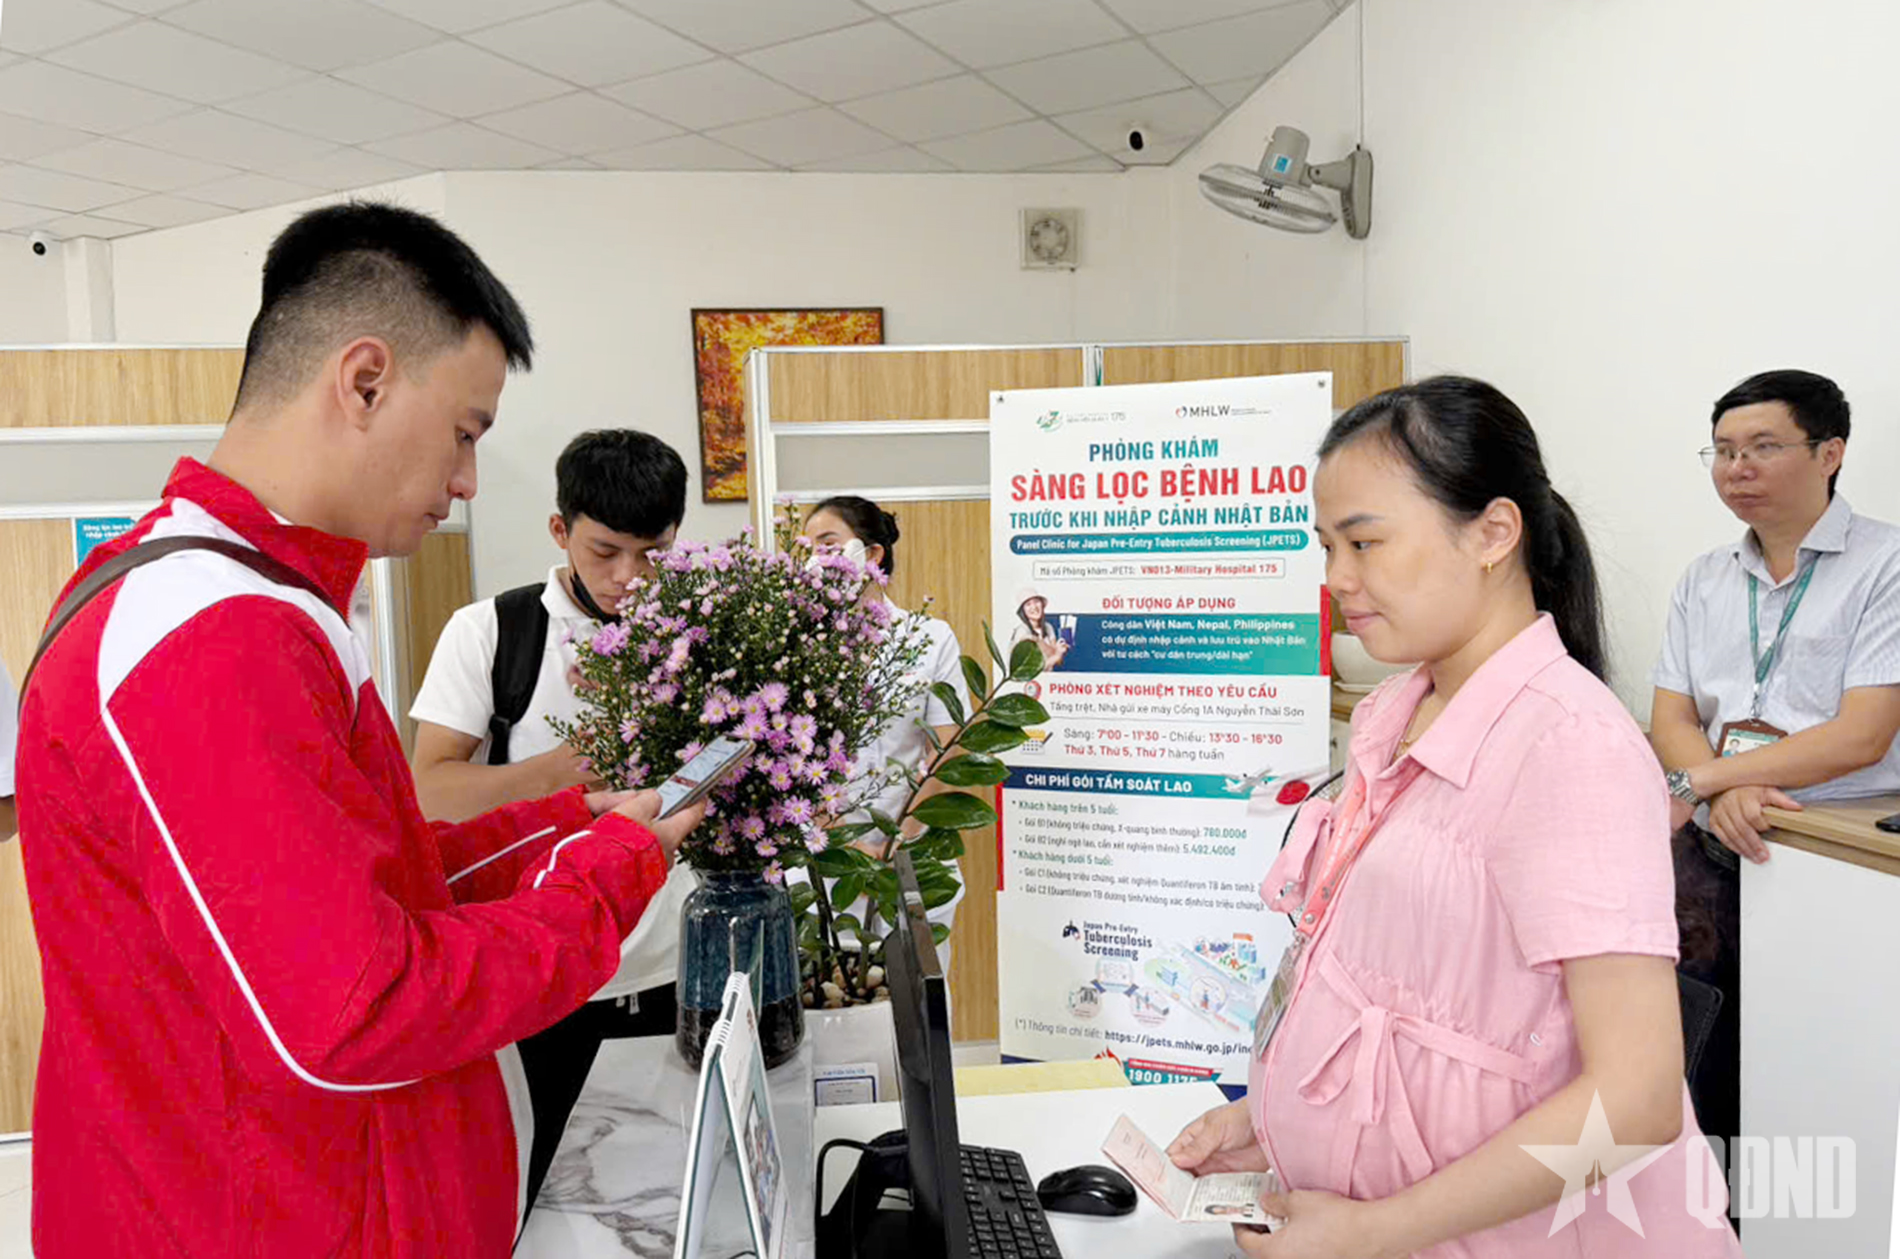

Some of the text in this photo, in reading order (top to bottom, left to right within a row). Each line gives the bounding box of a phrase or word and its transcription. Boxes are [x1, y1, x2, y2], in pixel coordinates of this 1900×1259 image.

[1189, 405, 1230, 417] MHLW
[1089, 435, 1218, 462] PHÒNG KHÁM
[1011, 463, 1307, 505] SÀNG LỌC BỆNH LAO
[1009, 500, 1308, 530] TRƯỚC KHI NHẬP CẢNH NHẬT BẢN
[1017, 534, 1301, 550] Panel Clinic for Japan Pre-Entry Tuberculosis Screening (JPETS)
[1062, 565, 1086, 577] Phòng
[1109, 566, 1136, 575] JPETS:
[1215, 564, 1256, 576] Hospital
[1260, 564, 1277, 574] 175
[1102, 594, 1236, 612] ĐỐI TƯỢNG ÁP DỤNG
[1101, 619, 1295, 632] Công dân Việt Nam, Nepal, Philippines
[1127, 635, 1147, 646] định
[1148, 635, 1171, 647] nhập
[1261, 635, 1285, 647] Nhật
[1127, 650, 1150, 660] cách
[1049, 681, 1277, 699] PHÒNG XÉT NGHIỆM THEO YÊU CẦU
[1203, 705, 1216, 715] 1A
[1216, 704, 1256, 718] Nguyễn
[1283, 706, 1305, 717] Sơn
[1087, 745, 1097, 757] 3,
[1122, 746, 1133, 758] 5,
[1159, 748, 1166, 758] 7
[1168, 748, 1197, 761] hàng
[1025, 774, 1047, 785] CHI
[1049, 771, 1070, 787] PHÍ
[1072, 774, 1094, 789] GÓI
[1126, 777, 1161, 791] SOÁT
[1164, 780, 1193, 792] LAO
[1019, 801, 1045, 811] Khách
[1047, 802, 1068, 814] hàng
[1091, 804, 1096, 813] 5
[1203, 827, 1247, 838] 780.000đ
[1018, 850, 1043, 860] Khách
[1045, 852, 1065, 864] hàng
[1087, 855, 1092, 864] 5
[1183, 844, 1236, 856] 5.492.400đ
[1084, 930, 1153, 948] Tuberculosis
[1084, 942, 1139, 961] Screening
[1028, 1020, 1054, 1035] Thông
[1055, 1026, 1067, 1034] tin
[1129, 1068, 1162, 1083] 1900
